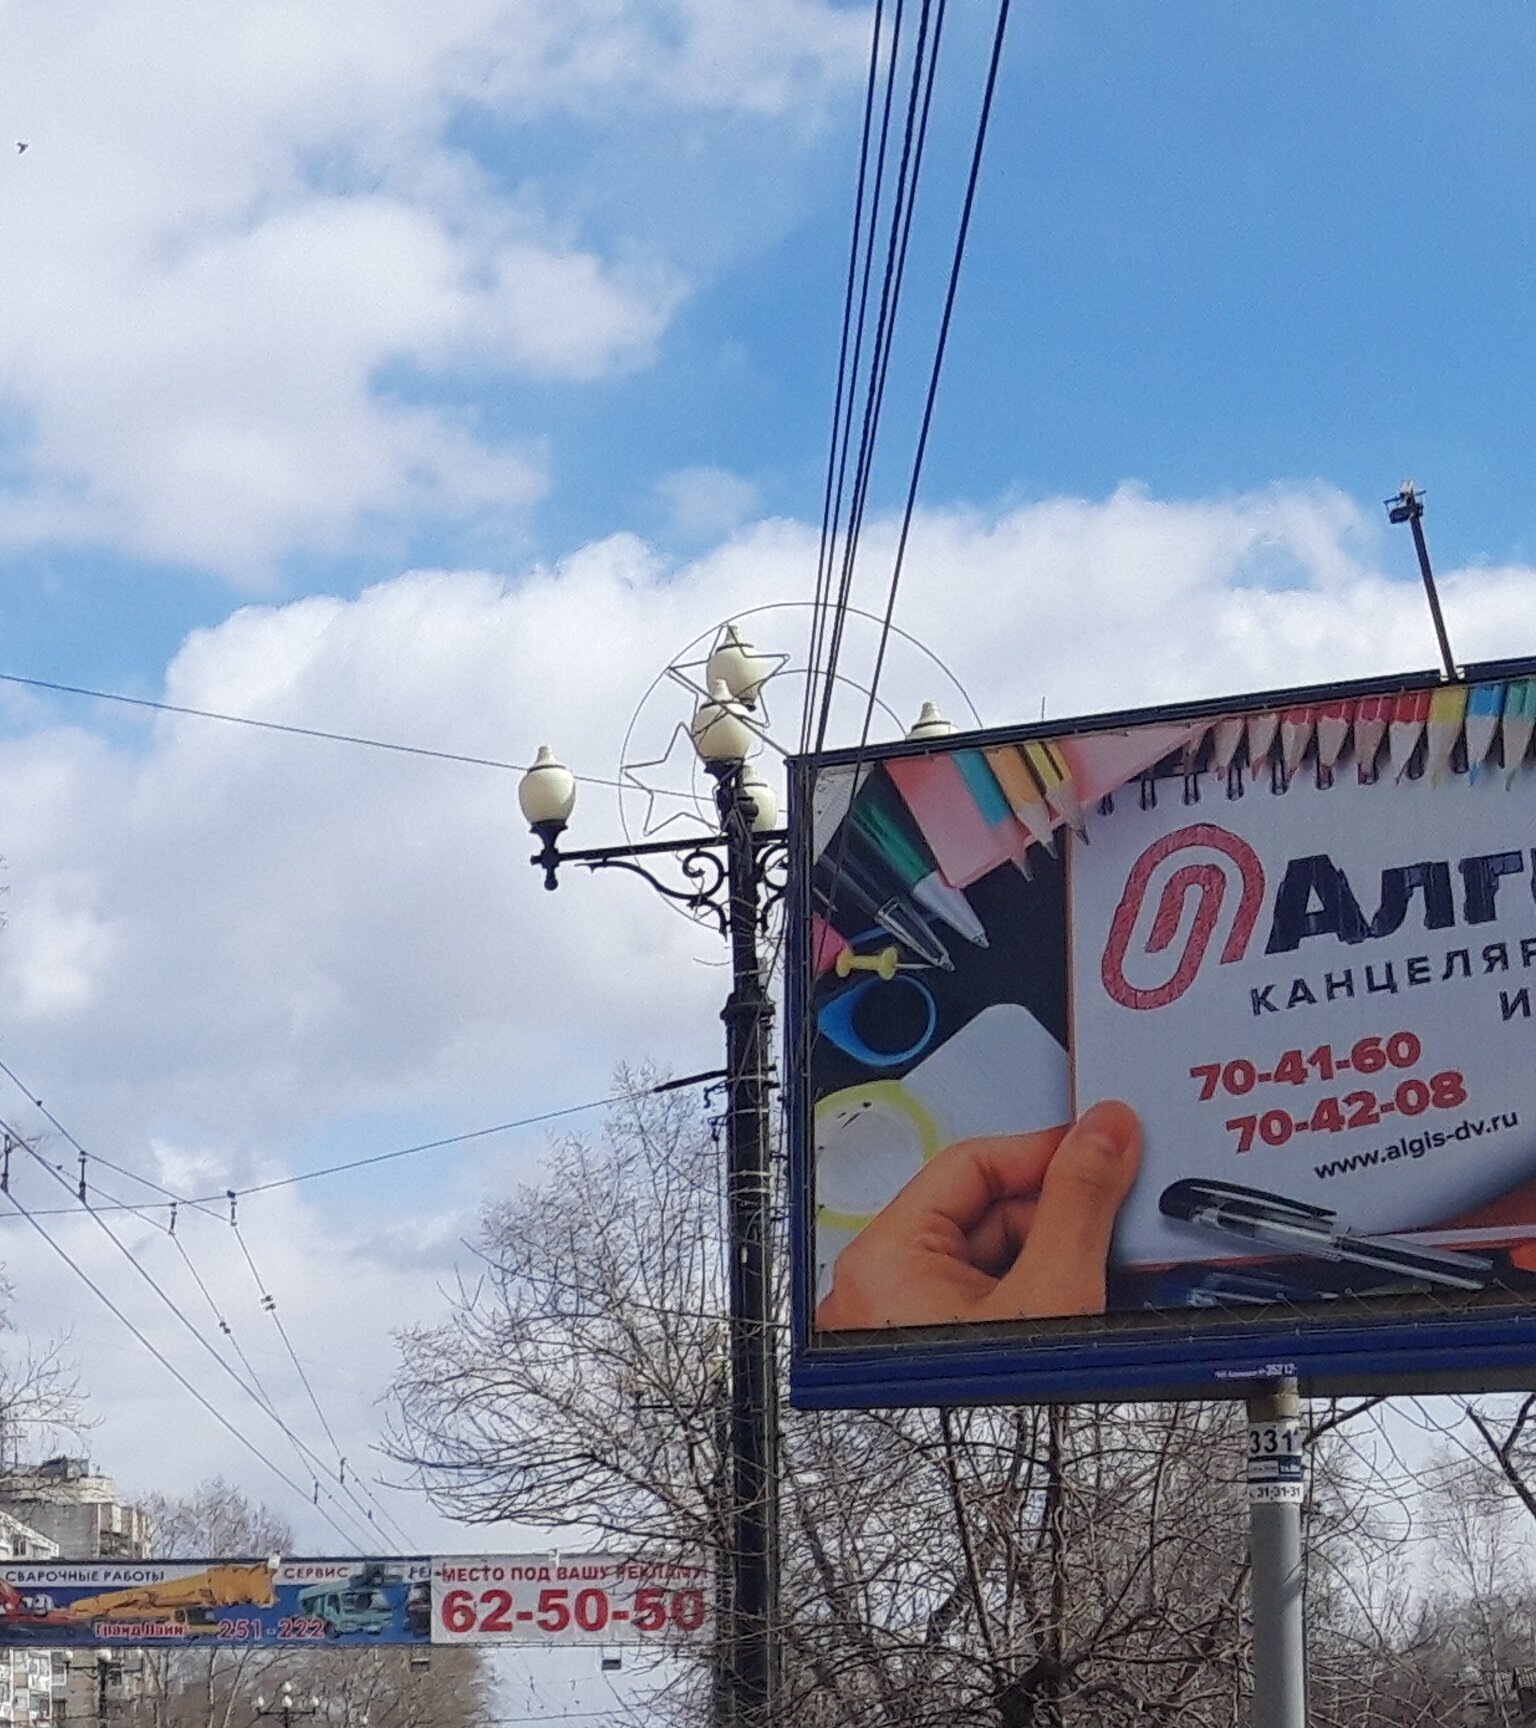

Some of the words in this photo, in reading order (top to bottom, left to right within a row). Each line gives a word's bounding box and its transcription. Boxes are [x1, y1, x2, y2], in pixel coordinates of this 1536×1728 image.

[1189, 1031, 1422, 1102] 70-41-60
[1226, 1071, 1468, 1154] 70-42-08
[1314, 1111, 1519, 1180] www.algis-dv.ru
[5, 1570, 99, 1582] СВАРОЧНЫЕ
[103, 1570, 165, 1582] РАБОТЫ
[283, 1567, 349, 1579] СЕРВИС
[442, 1567, 504, 1582] МЕСТО
[511, 1567, 550, 1582] ПОД
[558, 1565, 607, 1581] ВАШУ
[441, 1588, 705, 1633] 62-50-50
